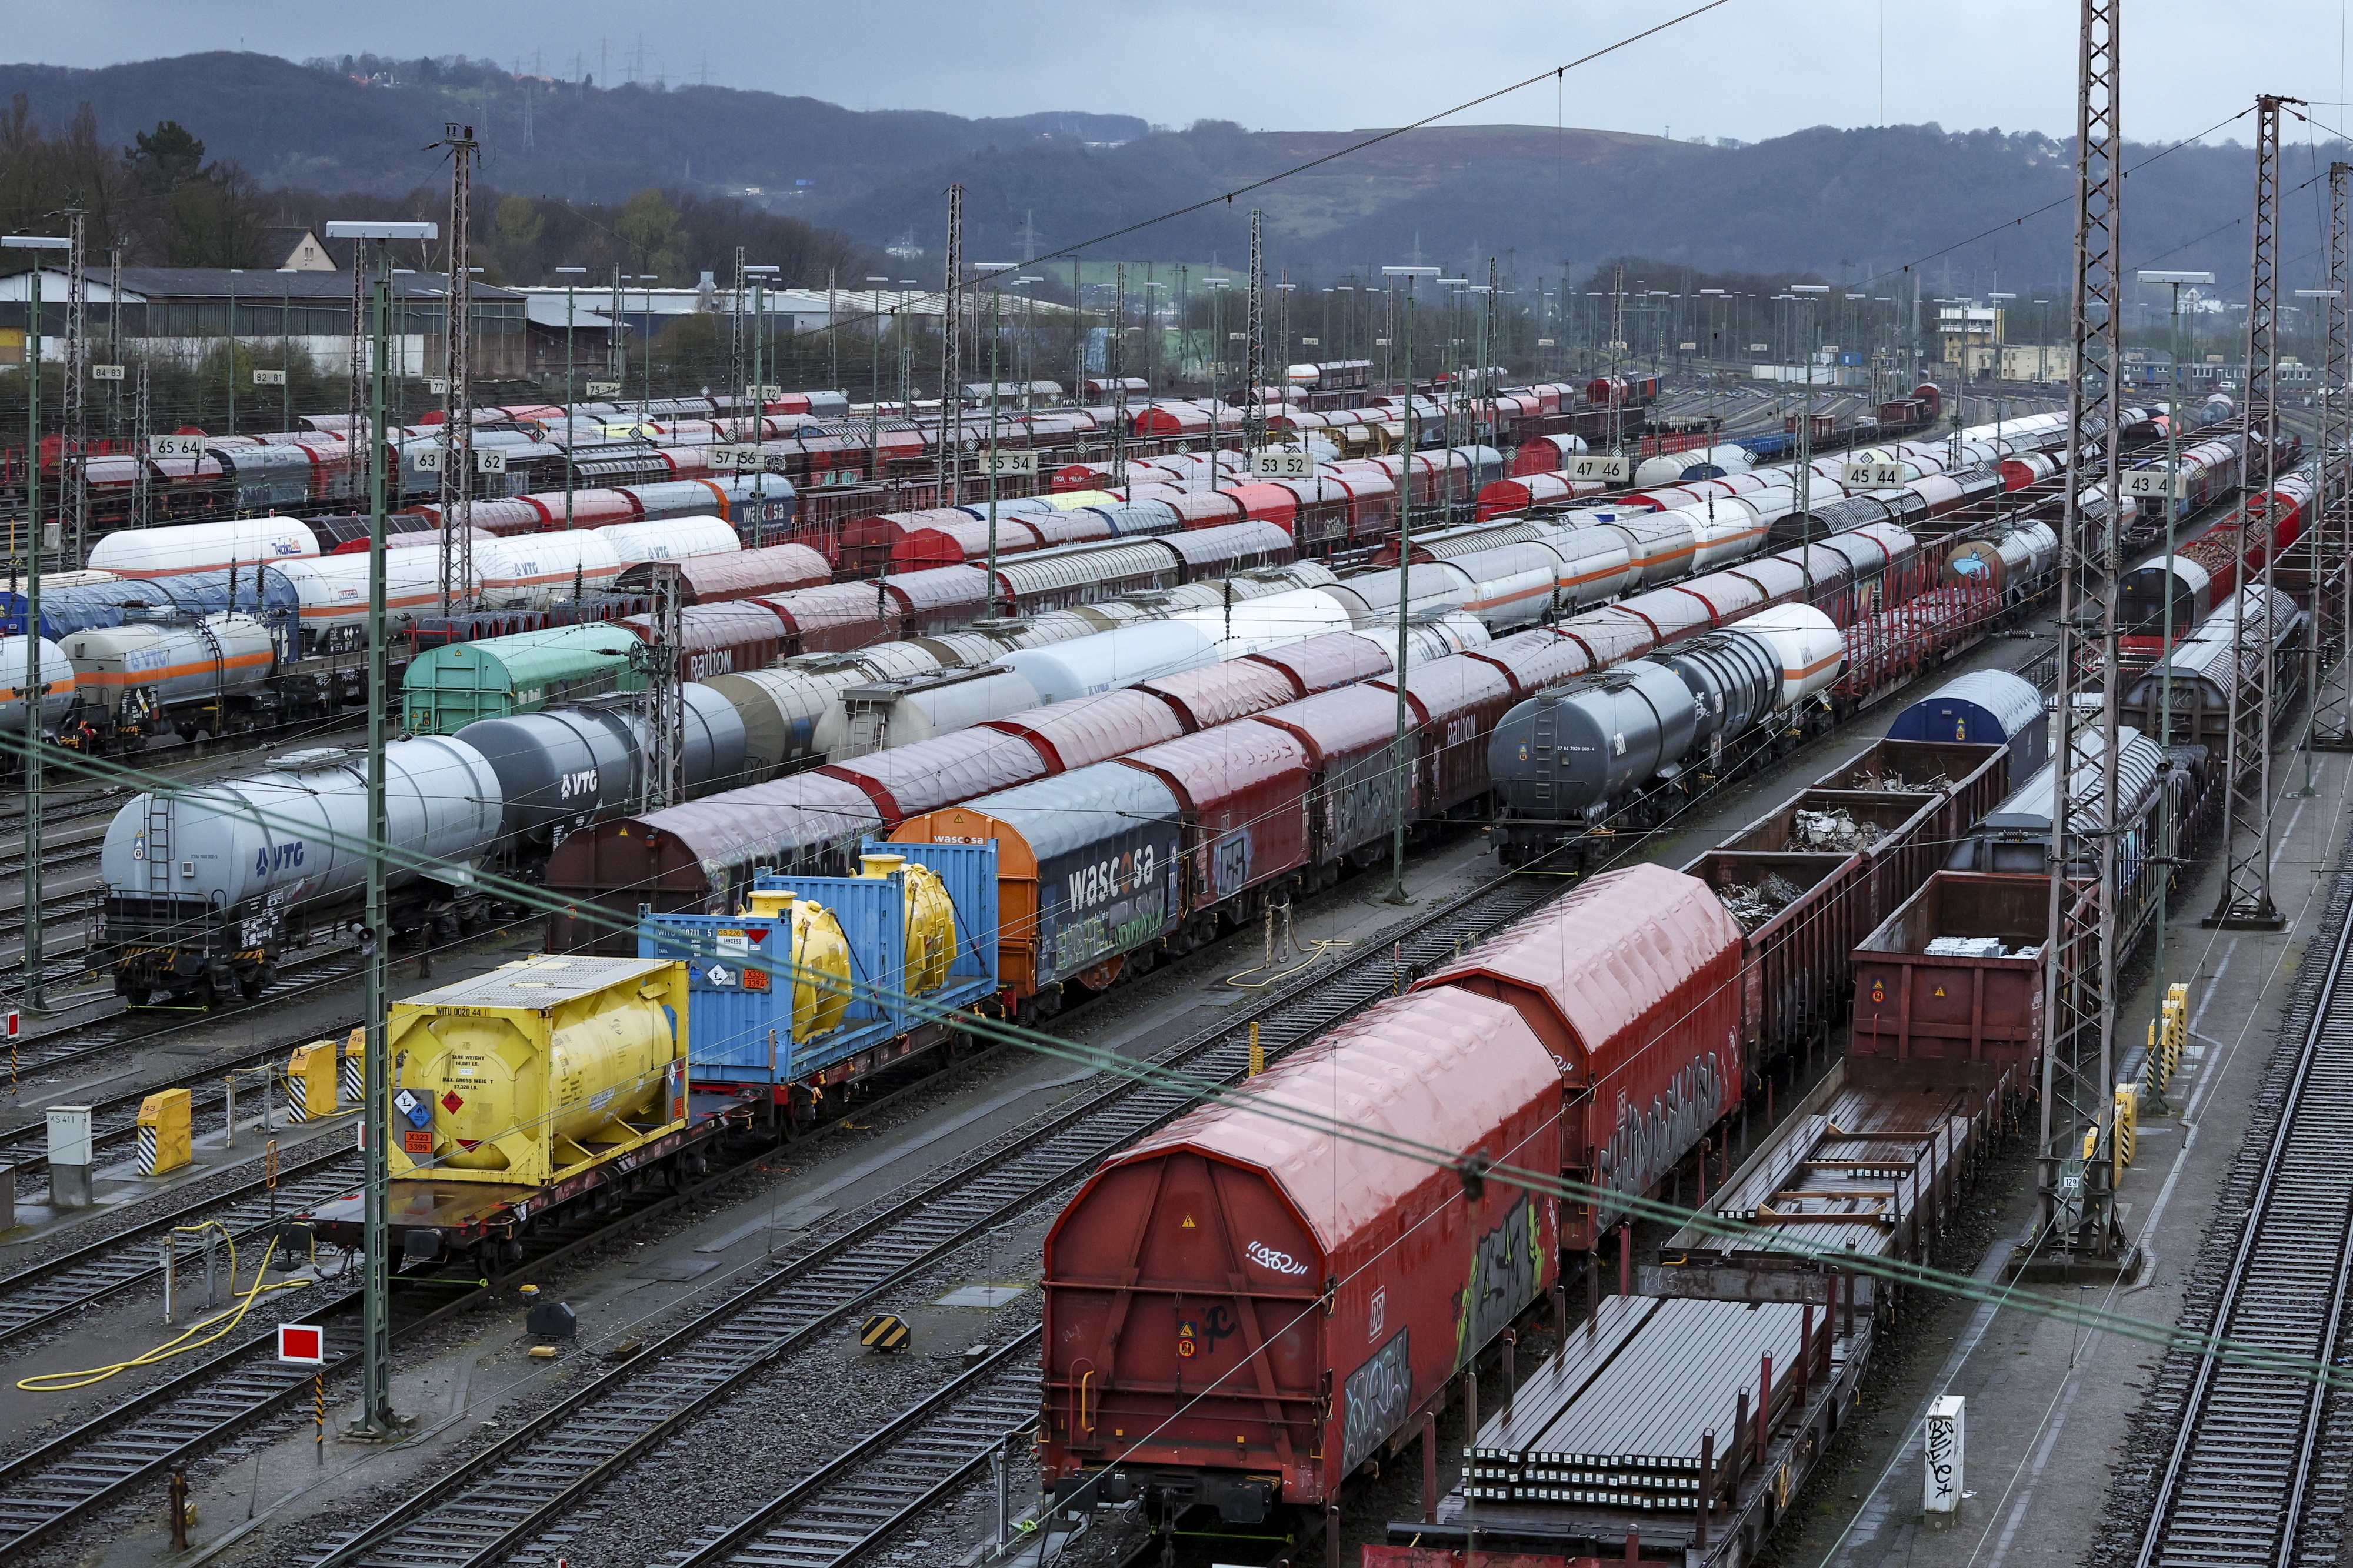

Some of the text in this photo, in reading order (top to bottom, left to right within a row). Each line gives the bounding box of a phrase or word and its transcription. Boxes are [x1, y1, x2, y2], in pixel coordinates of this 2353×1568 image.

[96, 369, 121, 377] 84 83
[257, 373, 282, 382] 82 81
[591, 386, 600, 394] 75
[766, 389, 776, 398] 72
[158, 441, 199, 453] 65 64
[419, 454, 435, 466] 63
[482, 455, 498, 468] 62
[715, 451, 731, 463] 57
[739, 451, 755, 465] 56
[1012, 456, 1029, 470] 54
[1261, 459, 1303, 472] 53 52
[1576, 462, 1619, 476] 47 46
[1850, 469, 1895, 483] 45 44
[2131, 477, 2171, 492] 43 4
[742, 503, 784, 523] wacosa
[654, 545, 669, 559] VTG
[522, 561, 538, 575] VTG
[339, 590, 358, 600] NACCO
[141, 649, 166, 668] VTG
[691, 645, 731, 681] Railion
[1448, 709, 1476, 750] Railion
[572, 769, 598, 796] VTG
[934, 835, 984, 845] wascosa
[273, 841, 304, 872] VTG
[1068, 843, 1154, 913] wascosa
[748, 979, 765, 987] 3394
[436, 1007, 452, 1016] WITU
[454, 1007, 469, 1017] 0020
[472, 1009, 481, 1017] 44
[1617, 1089, 1625, 1126] DB
[50, 1115, 61, 1123] KS
[409, 1133, 429, 1141] X323
[2065, 1178, 2077, 1187] 129
[1370, 1289, 1384, 1340] DB
